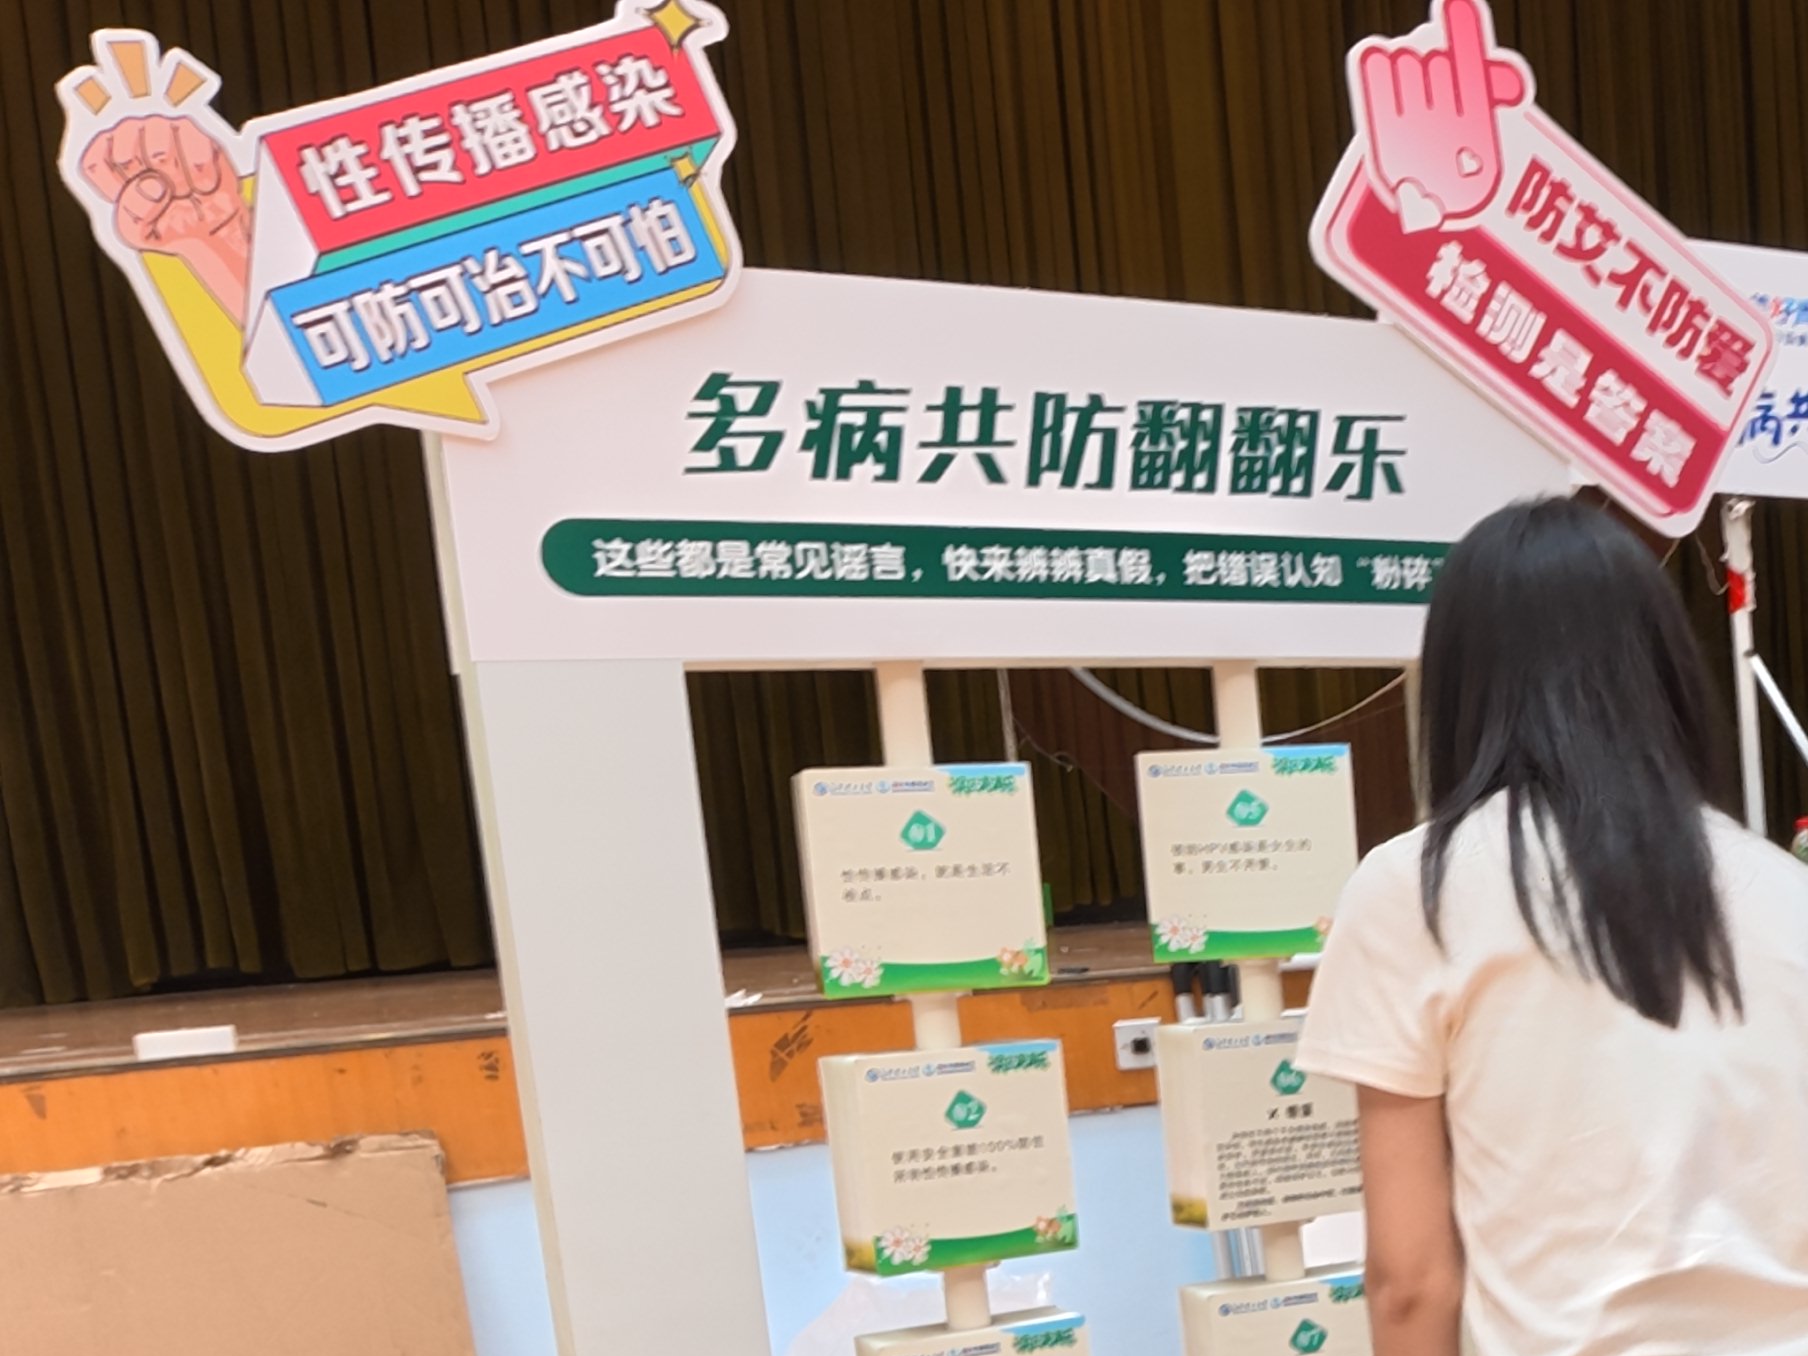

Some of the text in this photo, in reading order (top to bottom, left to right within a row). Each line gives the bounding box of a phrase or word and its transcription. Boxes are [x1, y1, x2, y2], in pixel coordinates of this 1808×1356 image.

[299, 54, 686, 219] 性传播感染
[292, 198, 697, 373] 可防可治不可怕
[1425, 240, 1697, 488] 检测是答案
[1505, 154, 1756, 399] 防艾不防爱
[683, 371, 1409, 502] 多病共防翻翻乐
